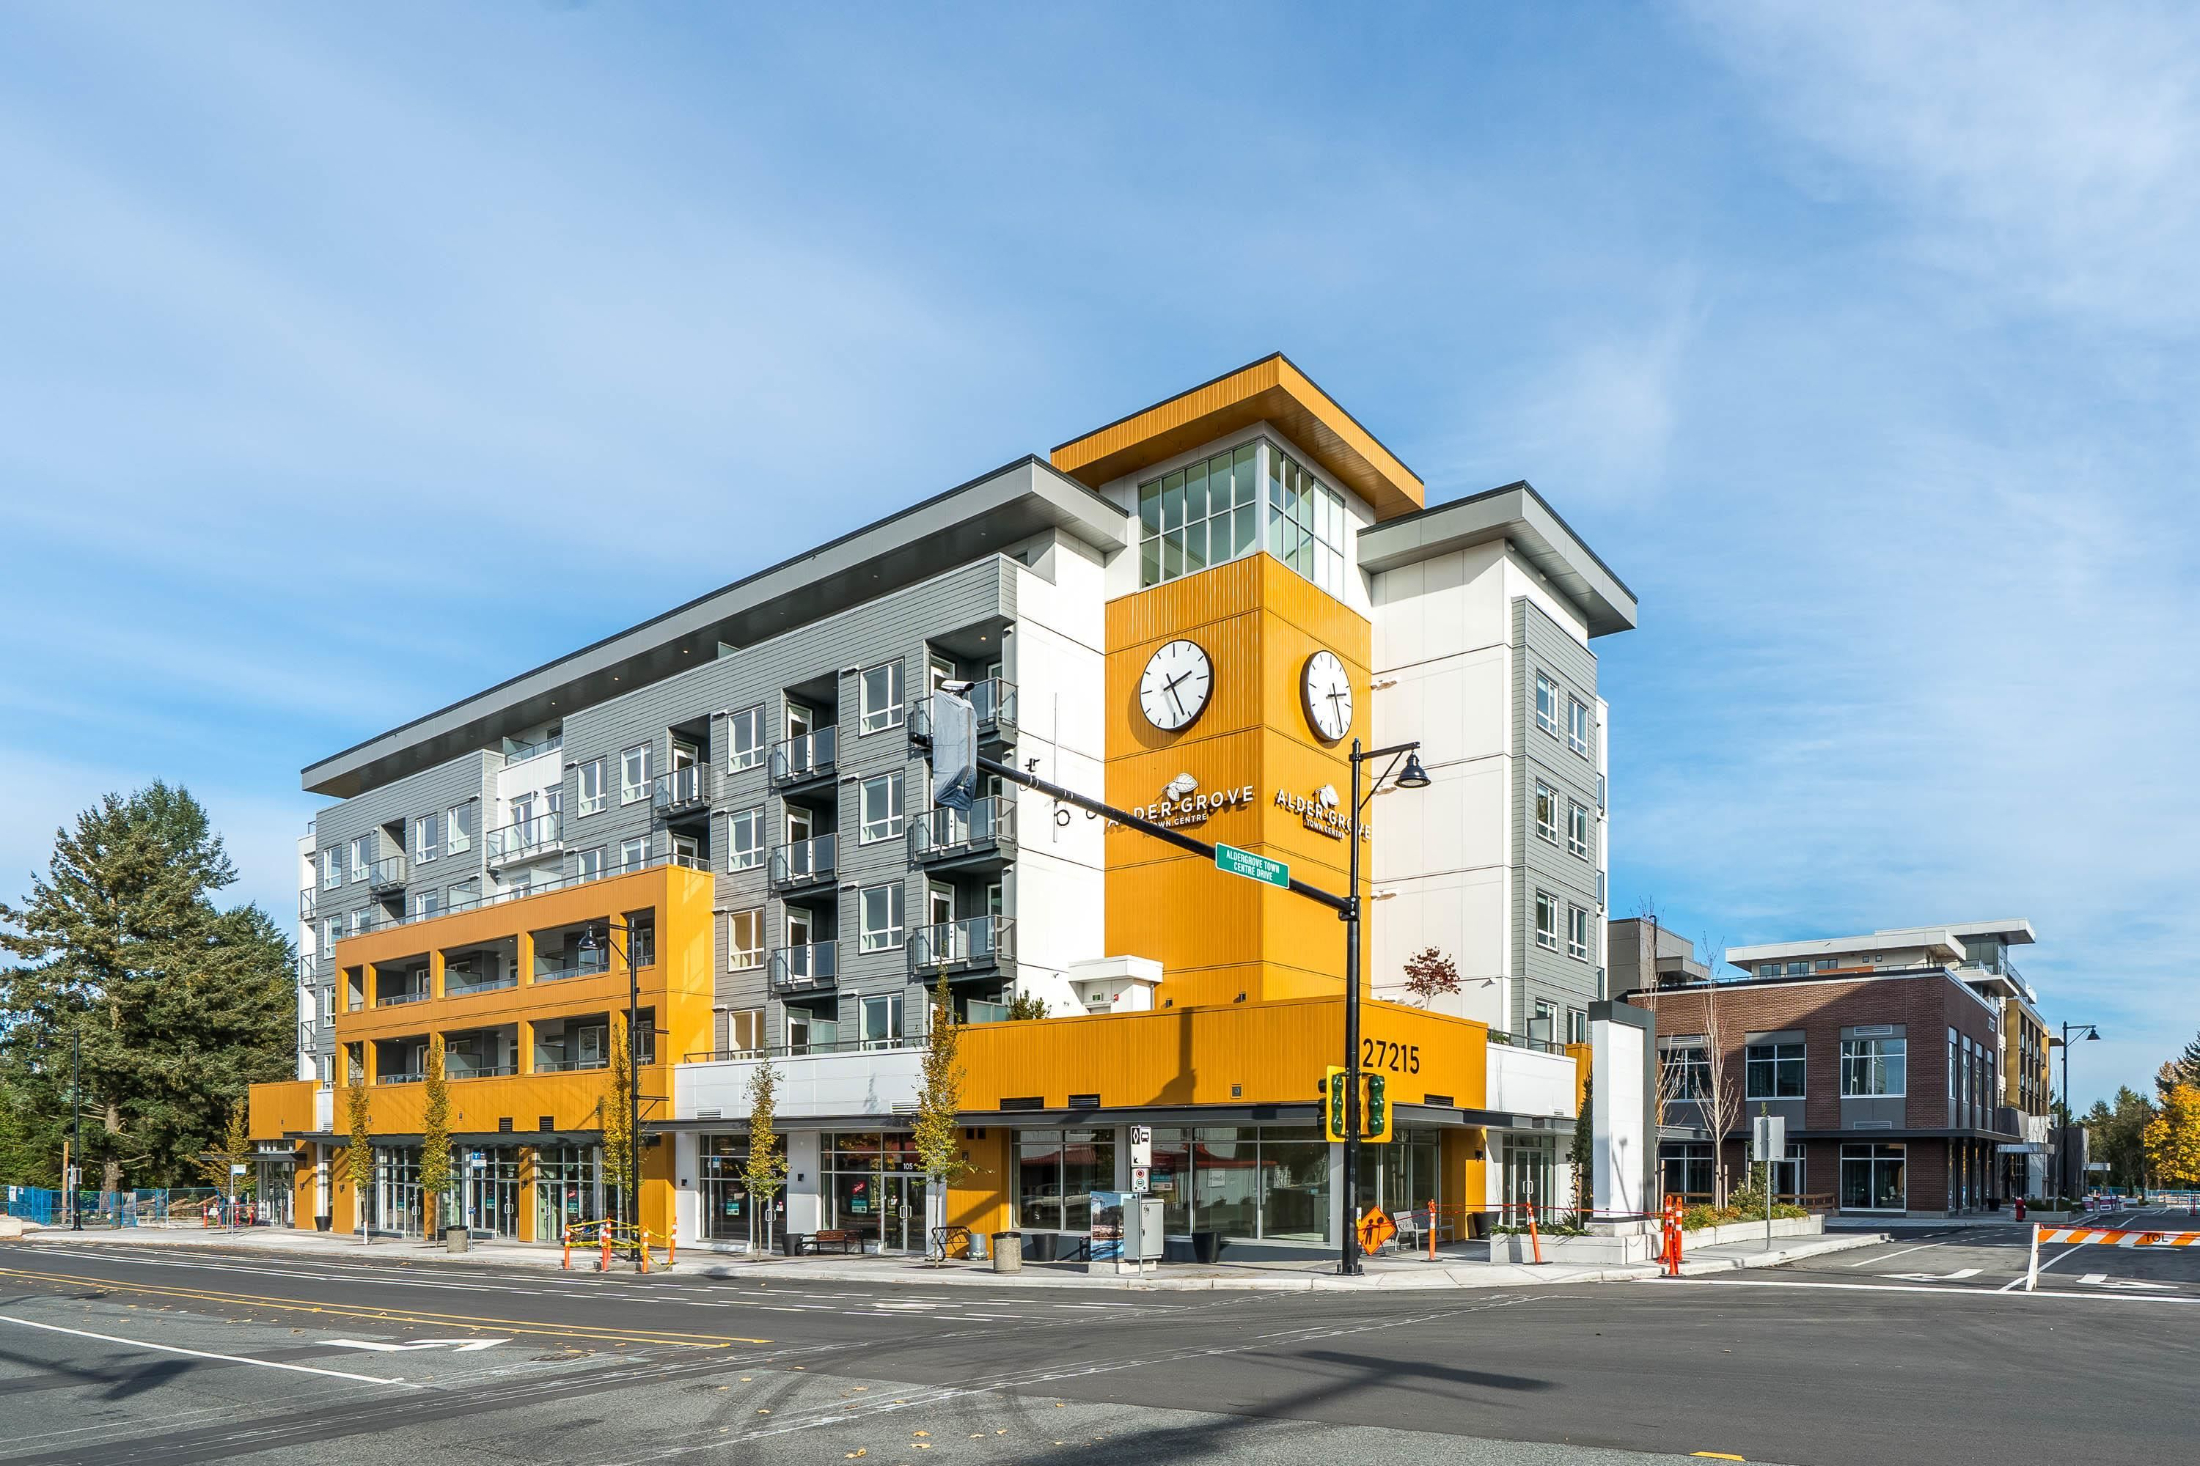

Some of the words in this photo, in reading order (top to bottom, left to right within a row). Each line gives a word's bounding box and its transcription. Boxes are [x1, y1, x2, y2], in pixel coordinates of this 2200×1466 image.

[1174, 813, 1207, 826] CENTRE
[1305, 817, 1322, 832] TOWN
[1226, 849, 1262, 869] ALDERGROVE
[1264, 861, 1280, 874] TOWN
[1233, 861, 1255, 876] CENTRE
[1256, 868, 1273, 881] DRIVE
[1363, 1038, 1419, 1074] 27215
[2145, 1233, 2168, 1242] TOL
